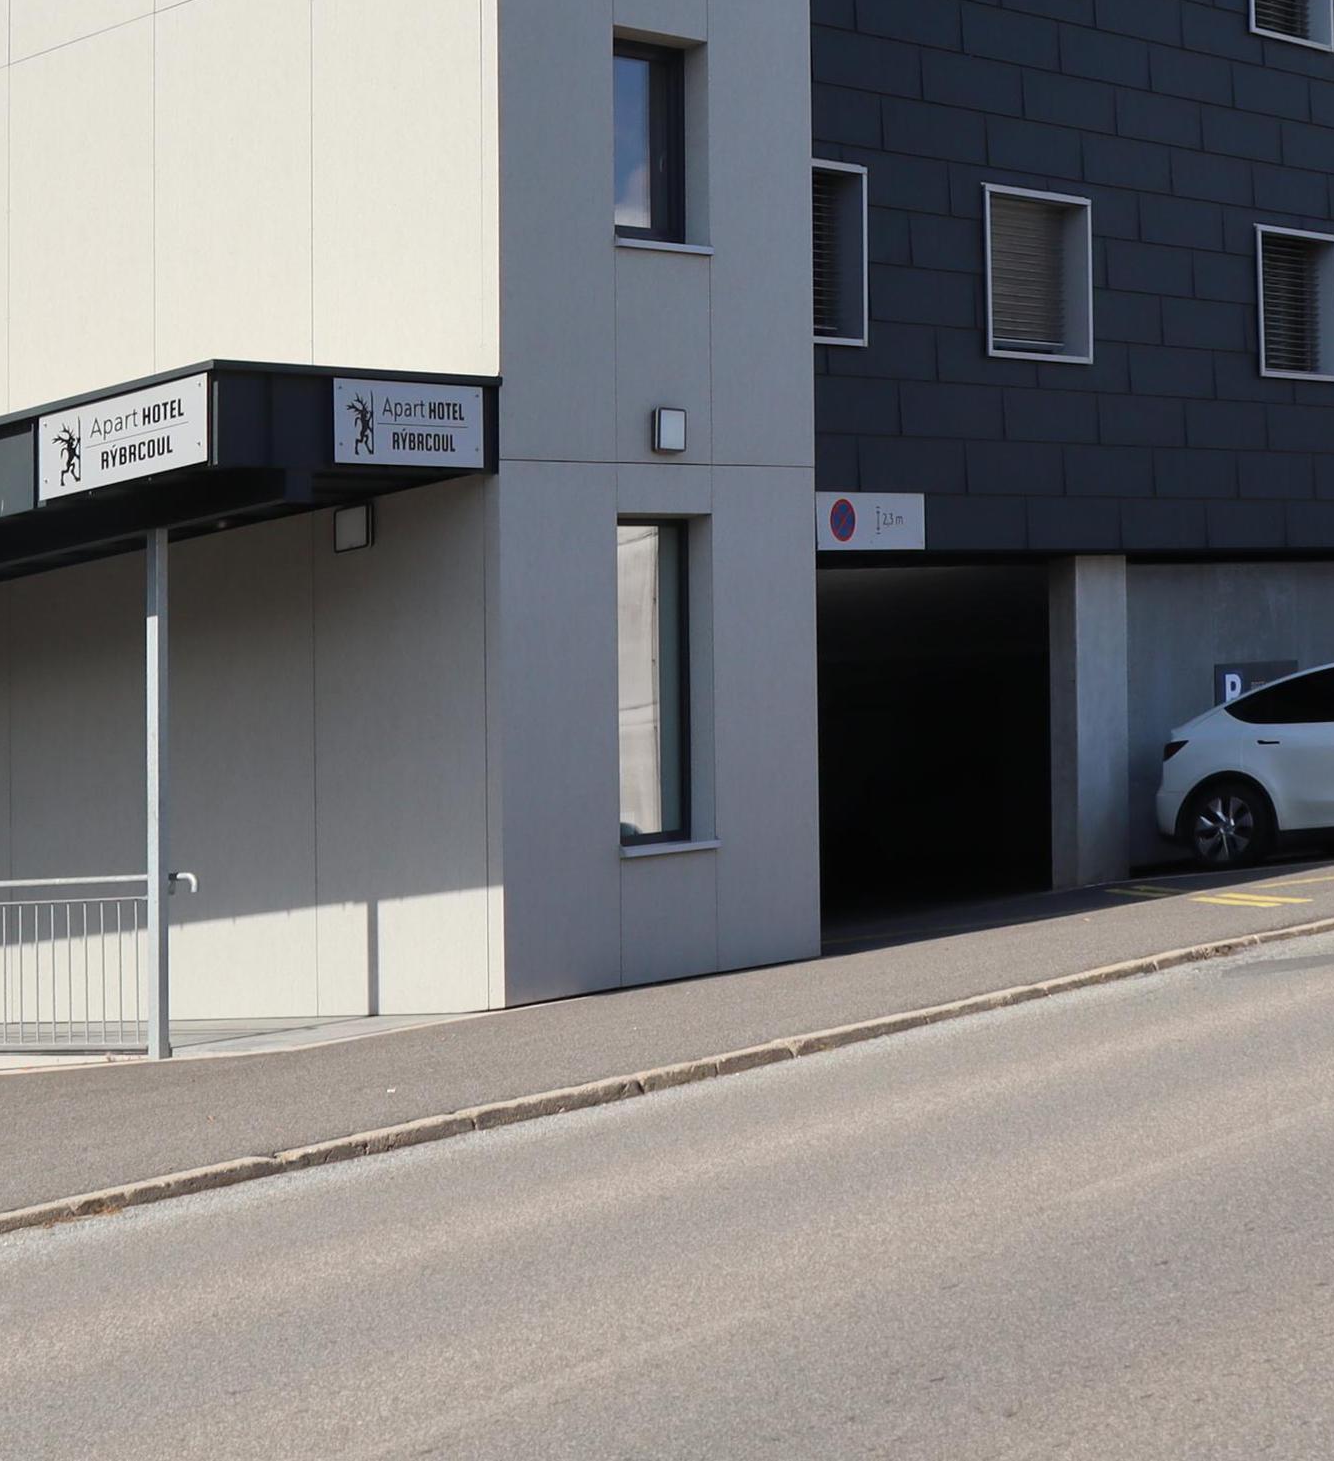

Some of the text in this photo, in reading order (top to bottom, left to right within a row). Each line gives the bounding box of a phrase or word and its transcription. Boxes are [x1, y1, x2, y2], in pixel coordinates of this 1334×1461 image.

[90, 398, 185, 439] Apart HOTEL
[381, 396, 465, 422] Apart HOTEL
[101, 435, 173, 471] RÝBRCOUL
[392, 426, 456, 453] RÝBRCOUL
